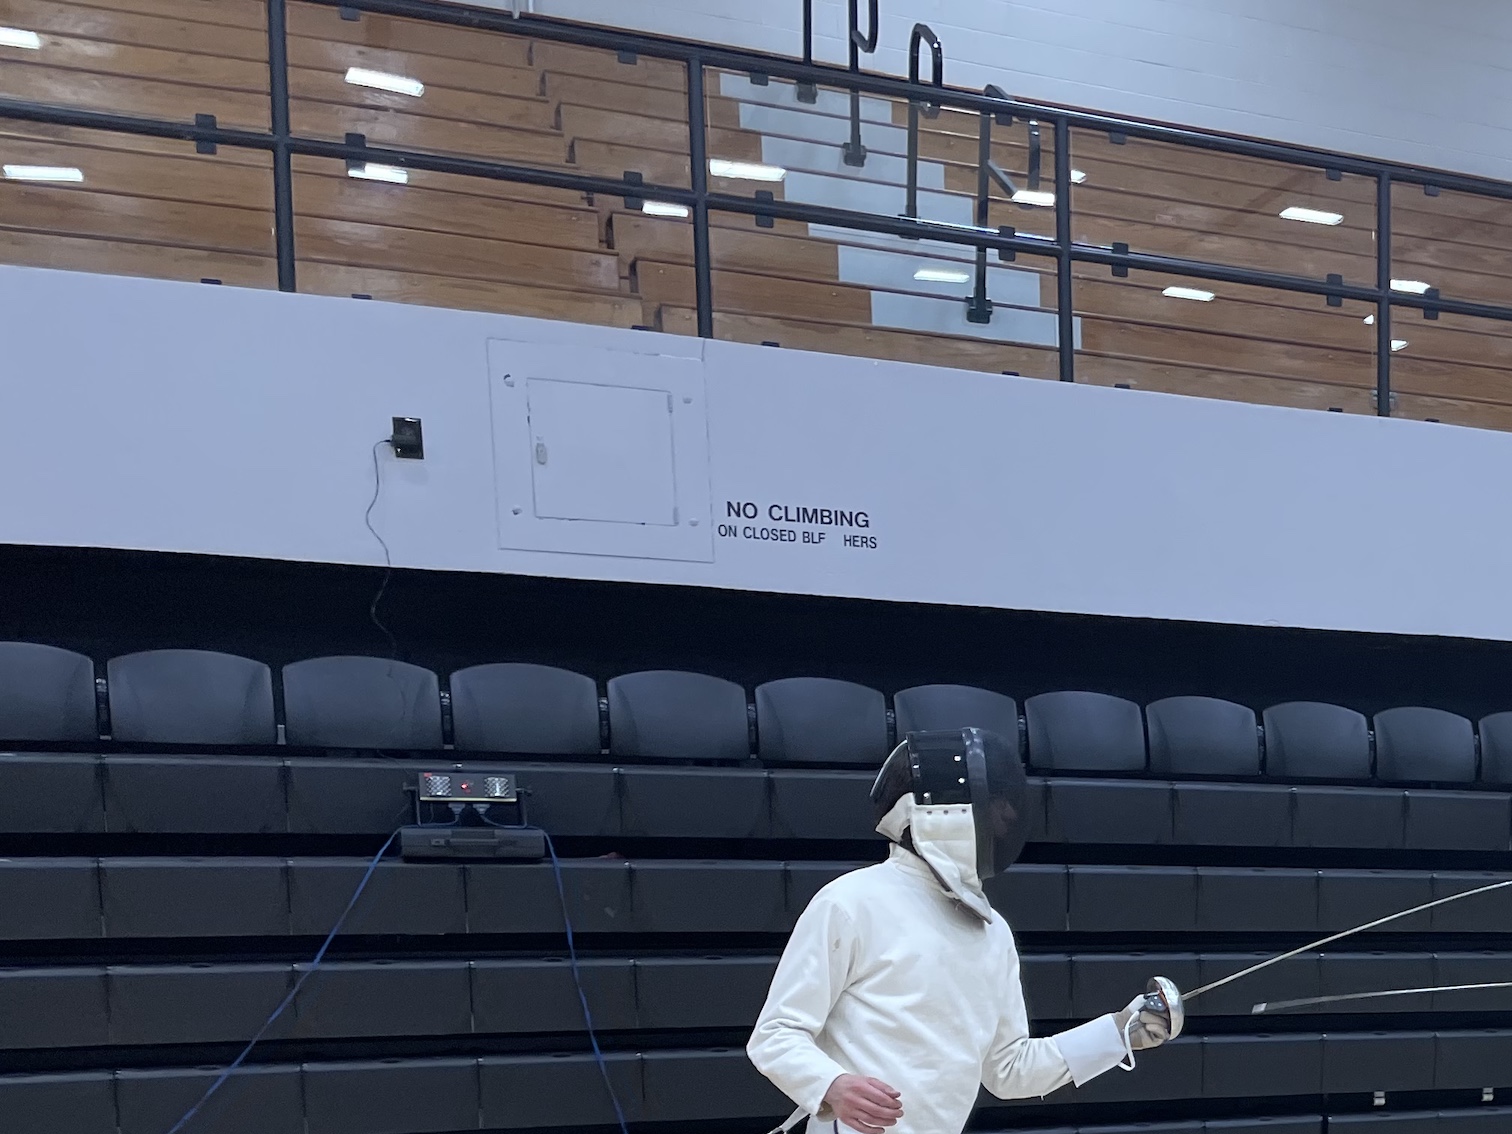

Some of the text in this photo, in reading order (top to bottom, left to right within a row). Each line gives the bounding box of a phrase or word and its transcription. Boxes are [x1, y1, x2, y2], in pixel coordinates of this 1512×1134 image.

[727, 501, 870, 528] NO CLIMBING
[718, 524, 737, 537] ON
[743, 526, 796, 542] CLOSED
